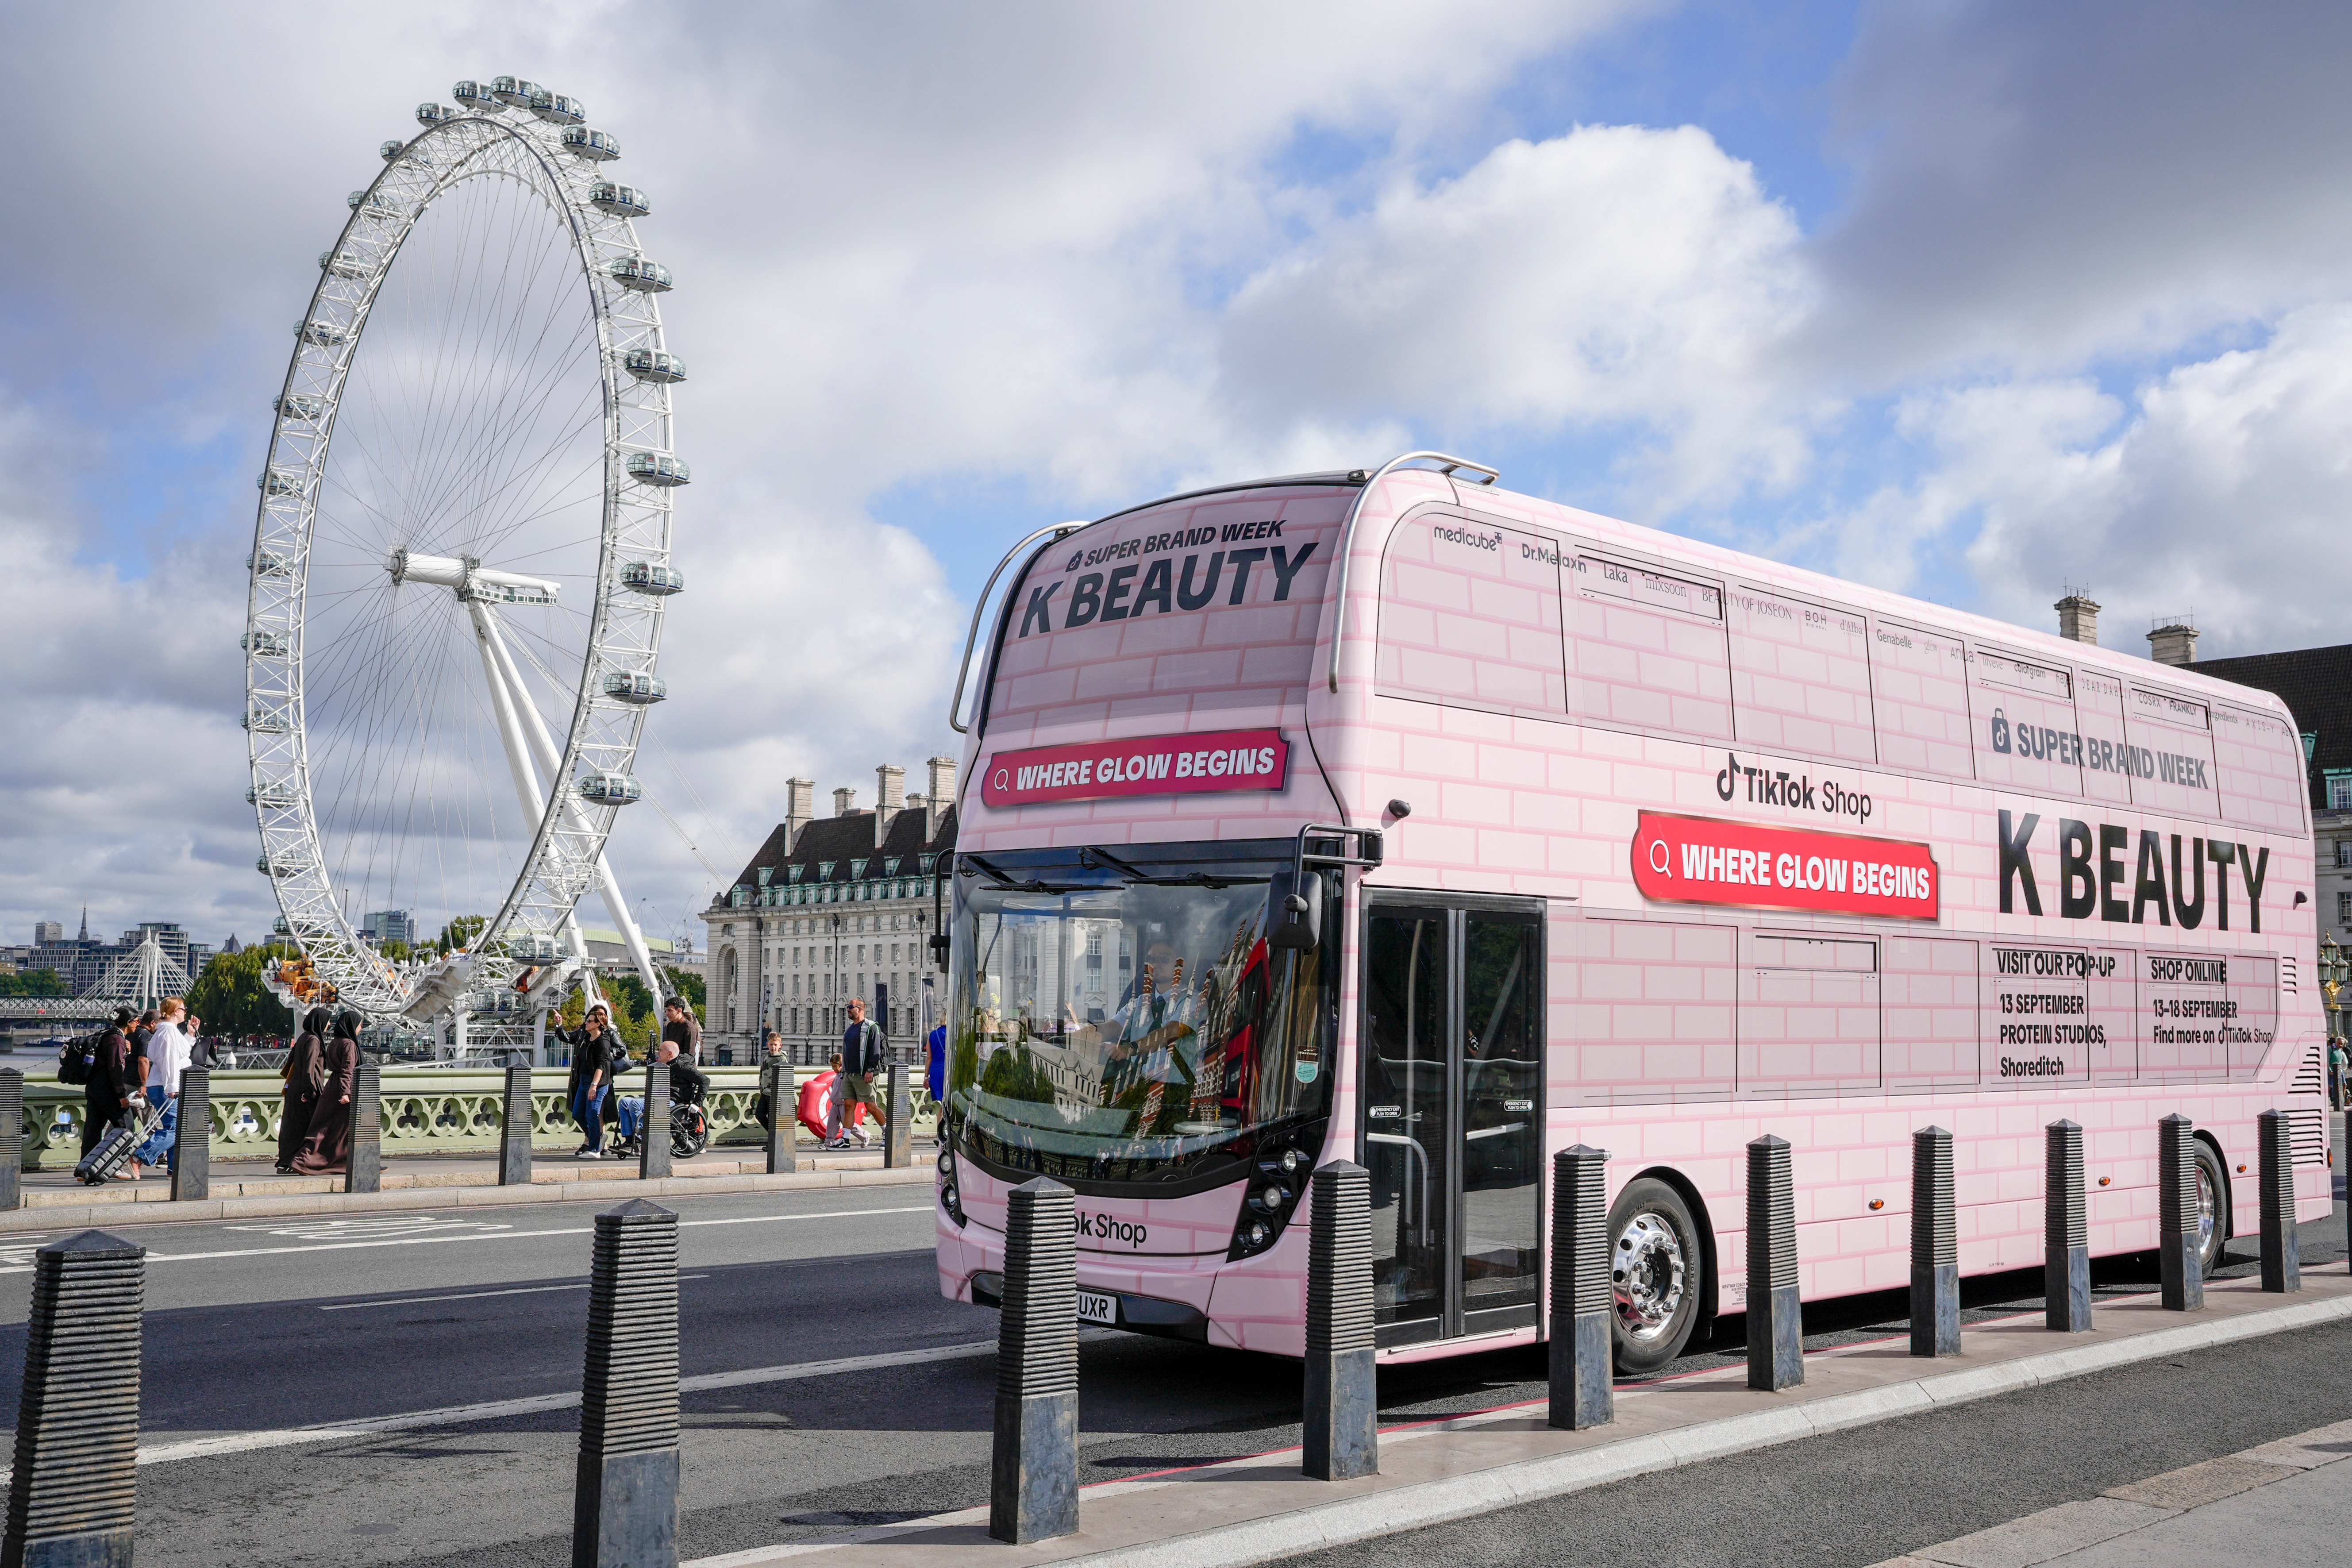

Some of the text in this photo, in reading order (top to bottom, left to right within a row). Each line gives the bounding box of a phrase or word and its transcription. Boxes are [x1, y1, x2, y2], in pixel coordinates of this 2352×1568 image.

[1084, 520, 1287, 567] SUPER BRAND WEEK
[1434, 526, 1497, 551] medicube
[1522, 543, 1587, 573] Dr.Melaxin
[1603, 563, 1628, 583] Laka
[1018, 542, 1320, 639] K BEAUTY
[1645, 578, 1687, 597] mixsoon
[1702, 588, 1792, 620] BEAUTY OF JOSEON
[1805, 610, 1827, 625] BOH
[1840, 619, 1863, 635] d'Alba
[1877, 629, 1912, 649] Genabelle
[1982, 655, 2004, 670] lilyeve
[2138, 693, 2161, 708] COSRX
[2169, 700, 2197, 716] FRANKLY
[2246, 718, 2274, 733] AXIS-Y
[2017, 722, 2209, 790] SUPER BRAND WEEK
[1016, 747, 1275, 791] WHERE GLOW BEGINS
[1744, 767, 1872, 824] TikTok Shop
[1682, 843, 1930, 901] WHERE GLOW BEGINS
[1998, 809, 2270, 934] K BEAUTY
[1997, 951, 2031, 974] VISIT
[2034, 953, 2063, 975] OUR
[2151, 959, 2227, 982] SHOP ONLINE
[2000, 994, 2084, 1015] 13 SEPTEMBER
[2182, 1000, 2238, 1018] SEPTEMBER
[2000, 1025, 2107, 1049] PROTEIN STUDIOS,
[2154, 1025, 2272, 1047] Find more on TikTok Shop
[2000, 1056, 2064, 1077] Shoreditch
[1095, 1213, 1147, 1249] Shop
[1079, 1295, 1109, 1319] UXR
